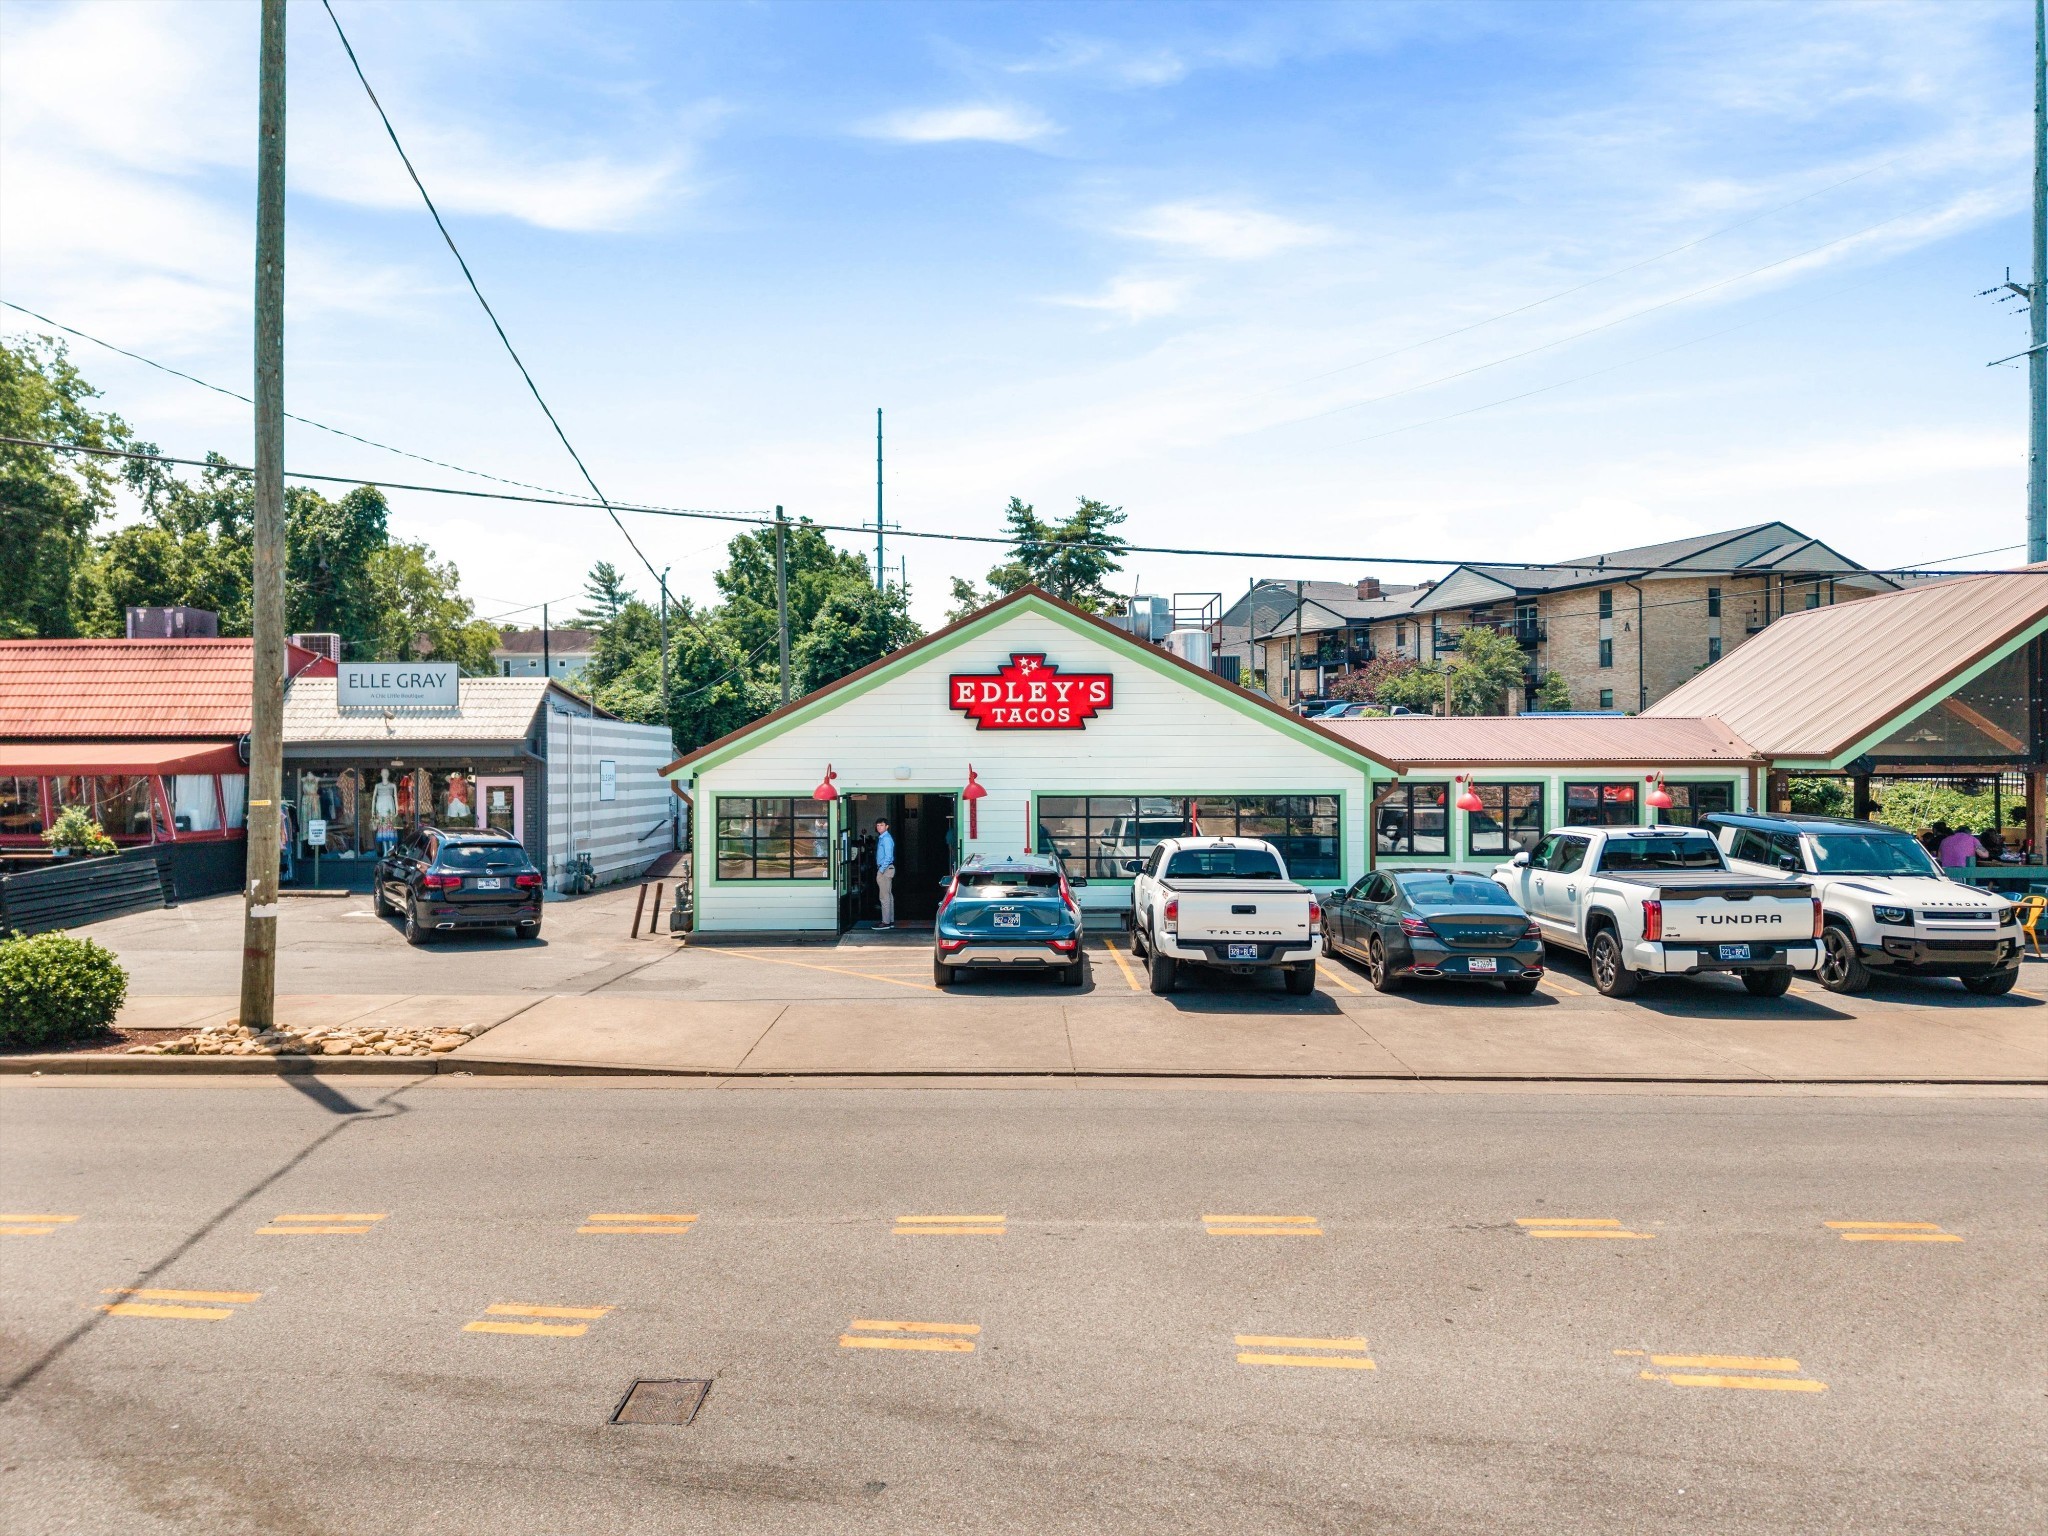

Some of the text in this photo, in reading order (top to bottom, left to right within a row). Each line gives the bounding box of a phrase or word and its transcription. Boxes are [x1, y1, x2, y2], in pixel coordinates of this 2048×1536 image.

[349, 673, 447, 688] ELLE GRAY
[956, 681, 1106, 703] EDLEY'S
[991, 707, 1070, 723] TACOS
[1696, 914, 1782, 924] TUNDRA
